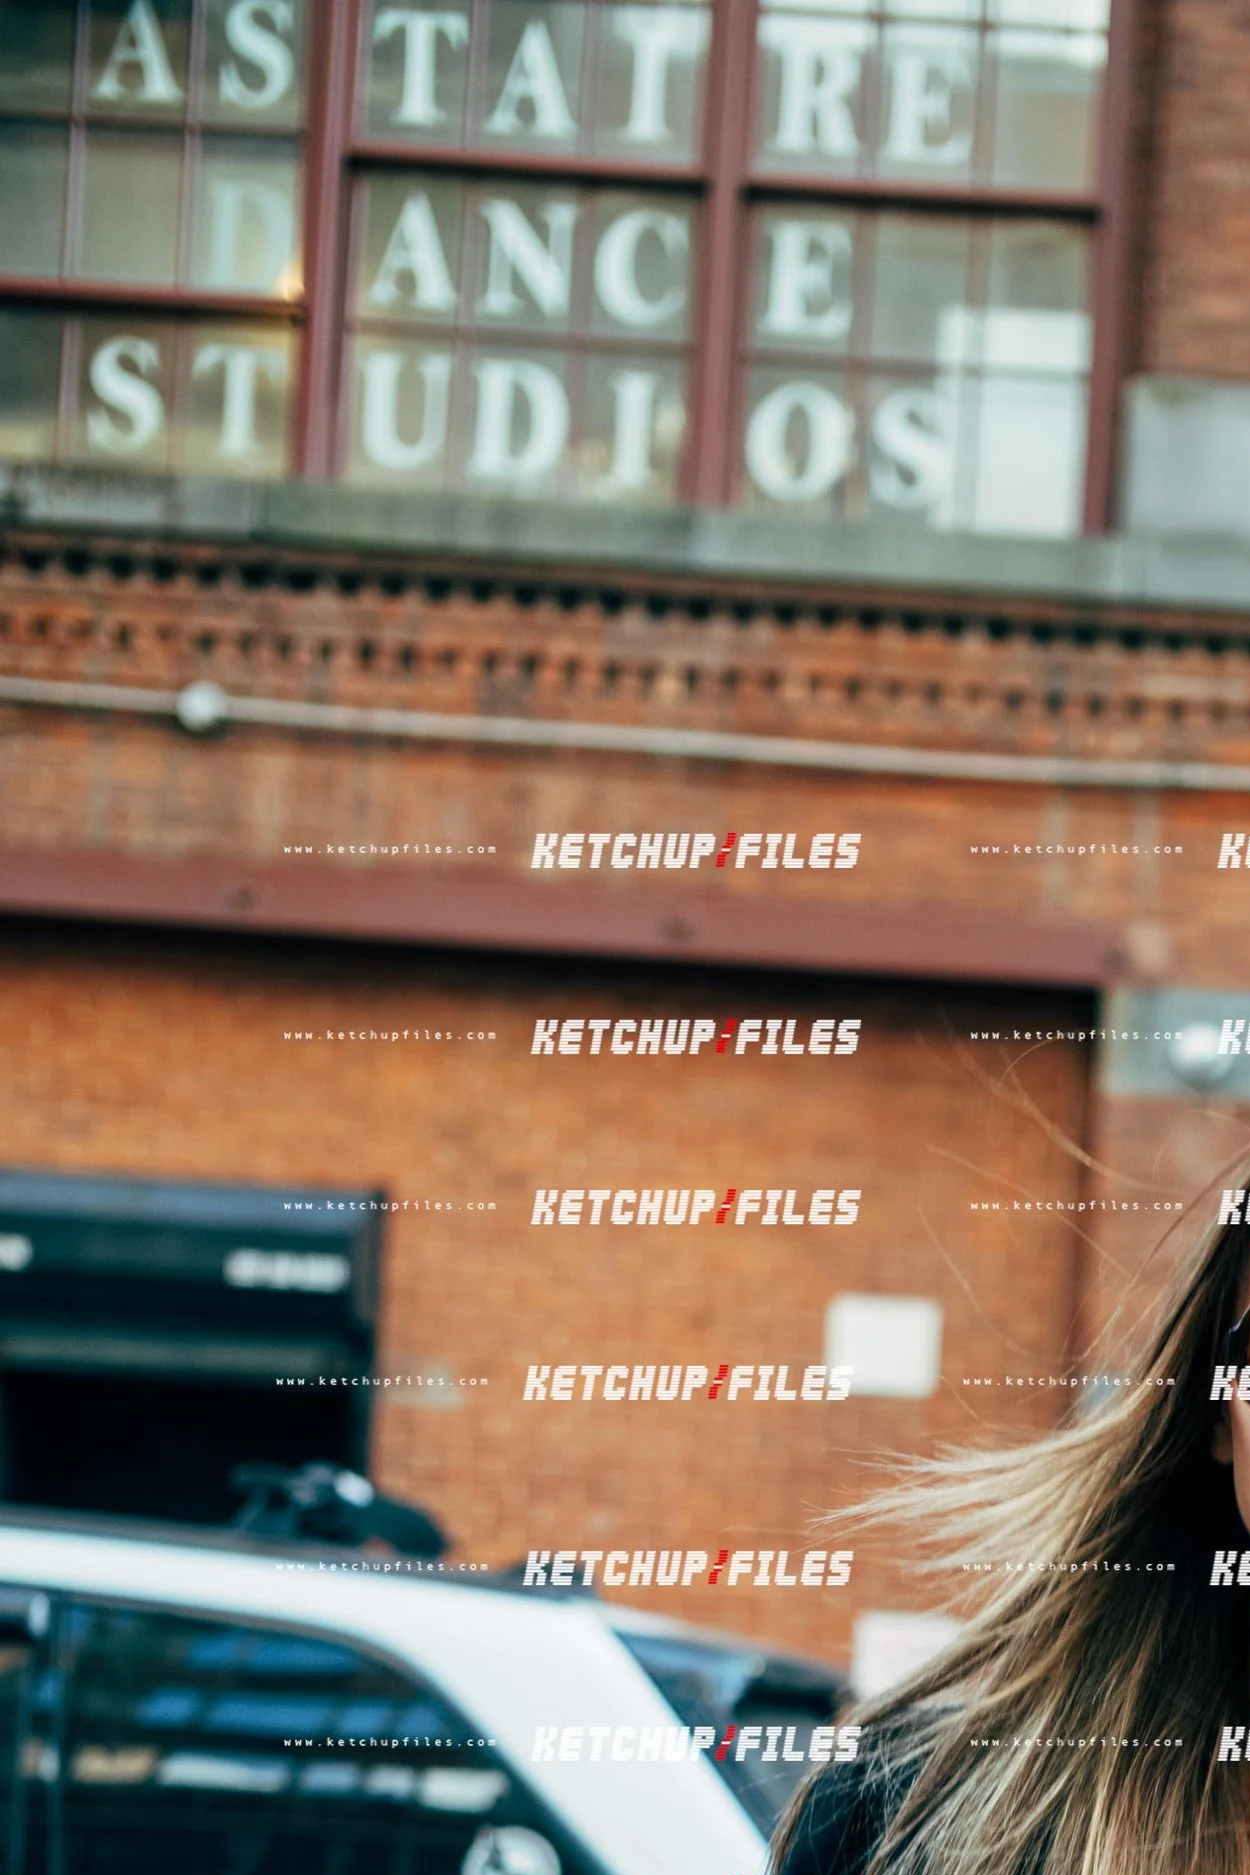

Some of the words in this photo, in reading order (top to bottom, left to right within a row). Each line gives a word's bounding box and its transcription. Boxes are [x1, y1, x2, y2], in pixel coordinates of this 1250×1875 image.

[95, 0, 975, 165] ASTAIRE
[207, 177, 853, 339] DANCE
[87, 336, 954, 508] STUDIOS
